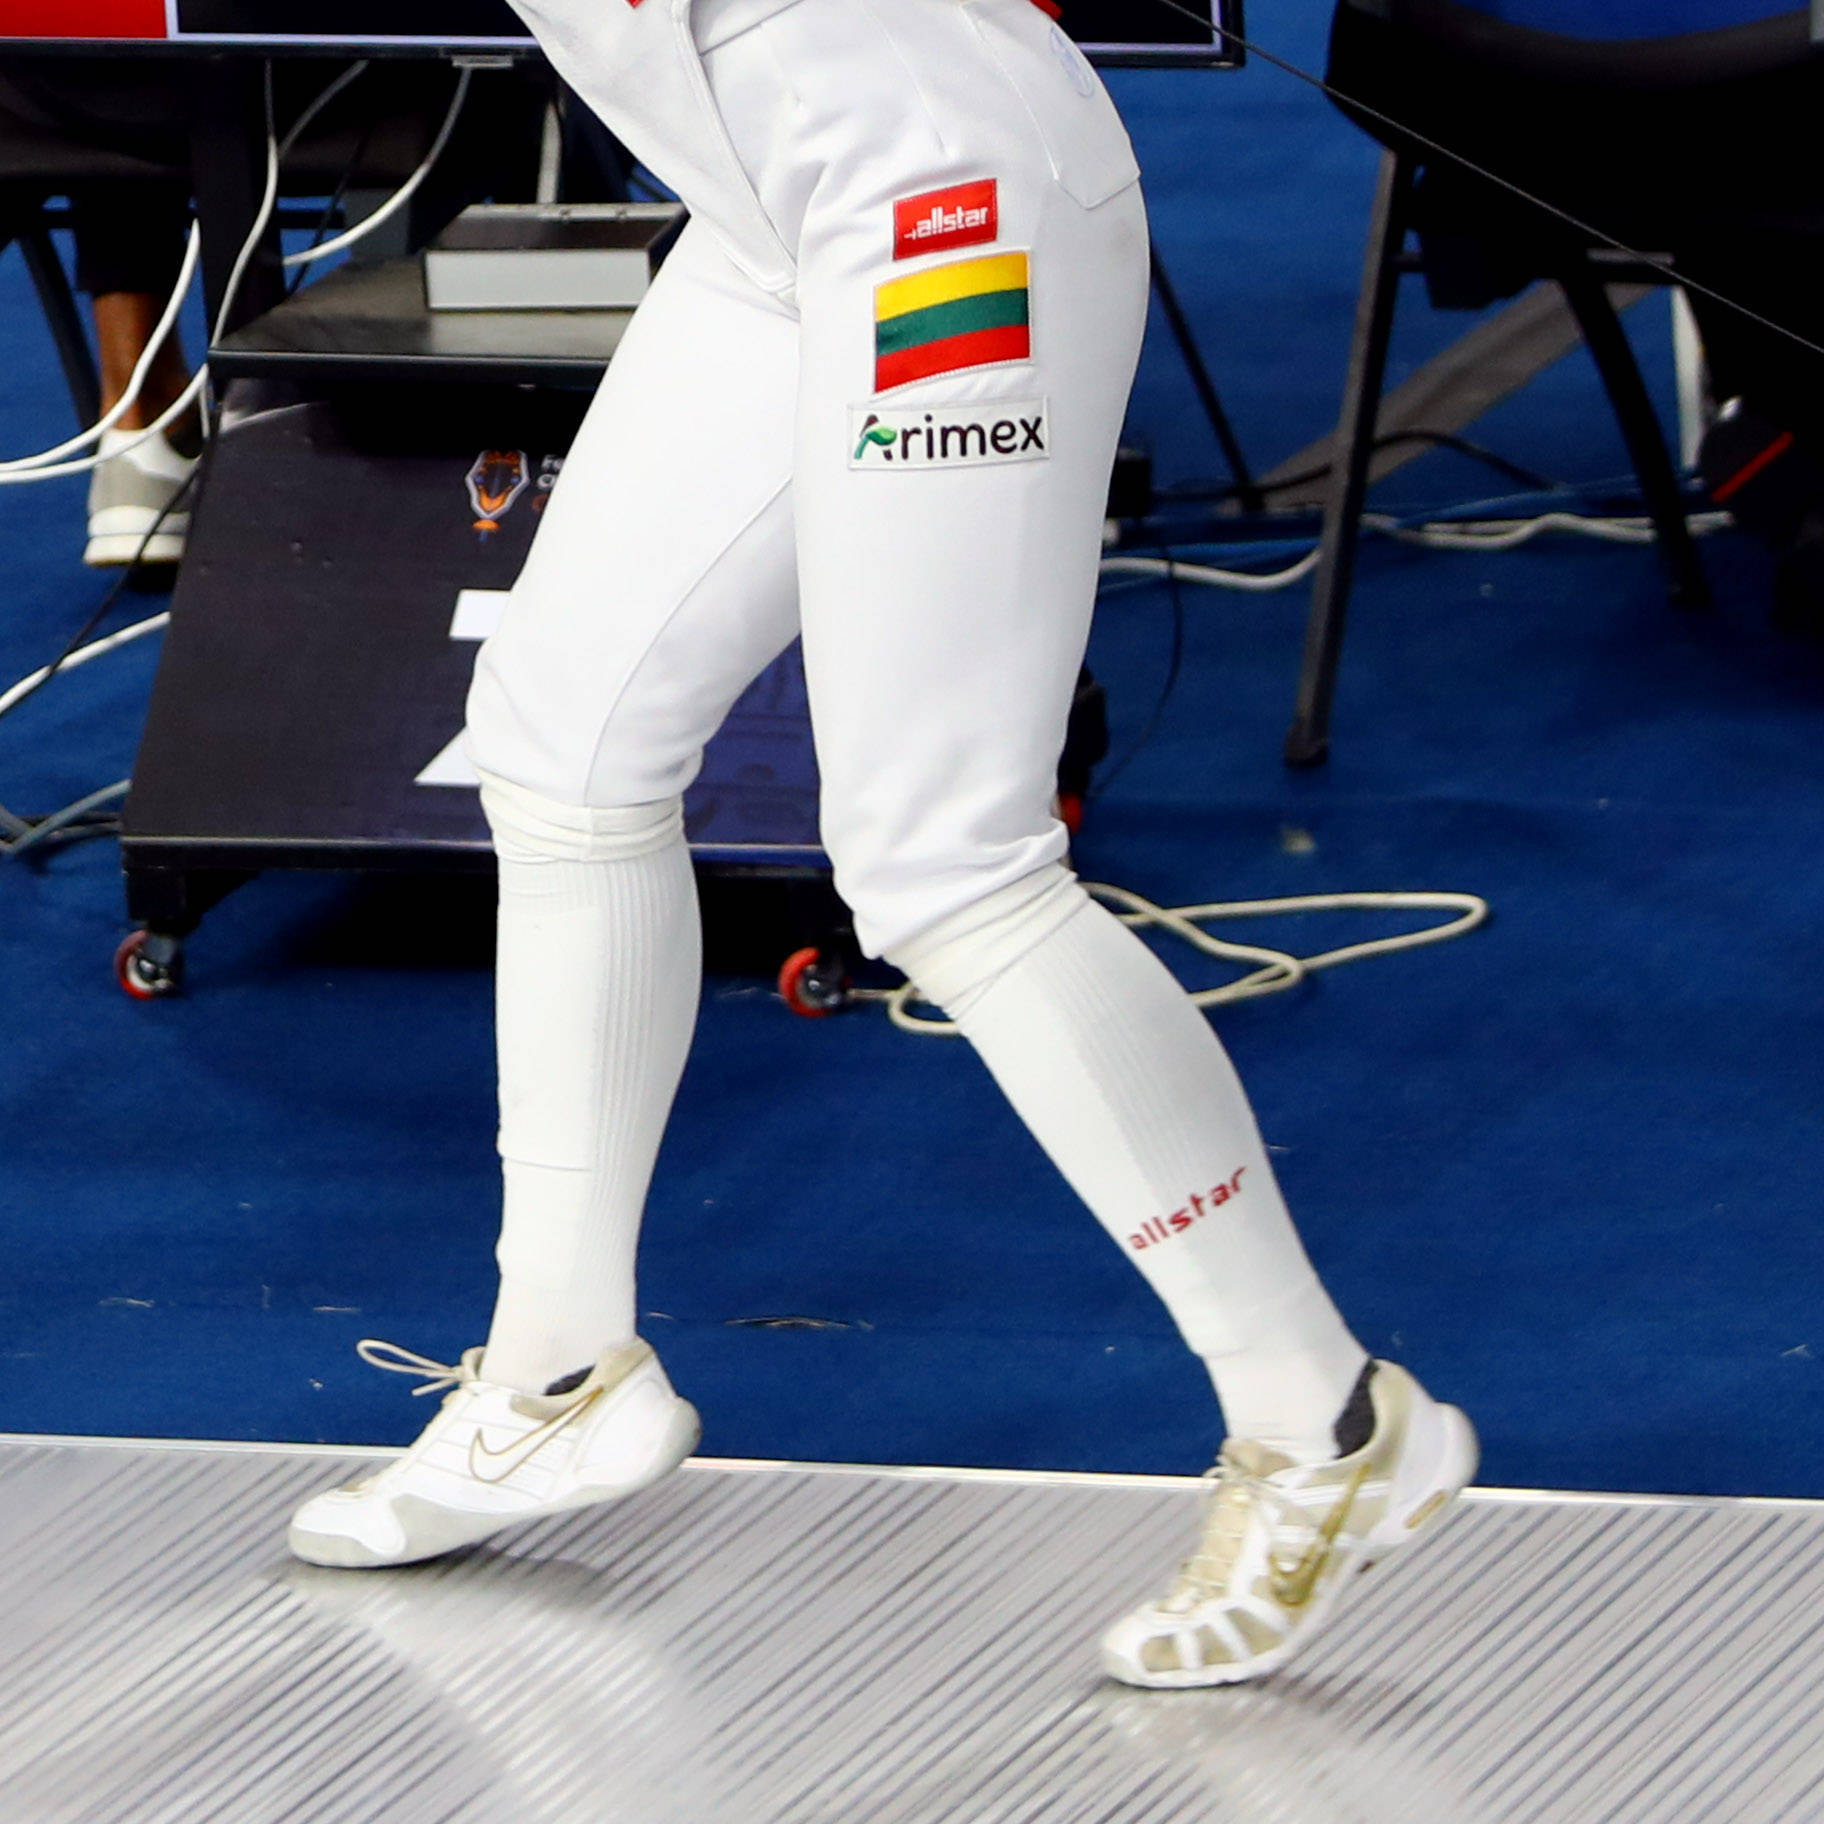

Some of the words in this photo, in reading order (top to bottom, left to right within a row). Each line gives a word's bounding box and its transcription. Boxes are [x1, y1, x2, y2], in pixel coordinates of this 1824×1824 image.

[911, 205, 990, 239] allstar
[853, 412, 1045, 462] Arimex
[1127, 1165, 1248, 1251] allstar
